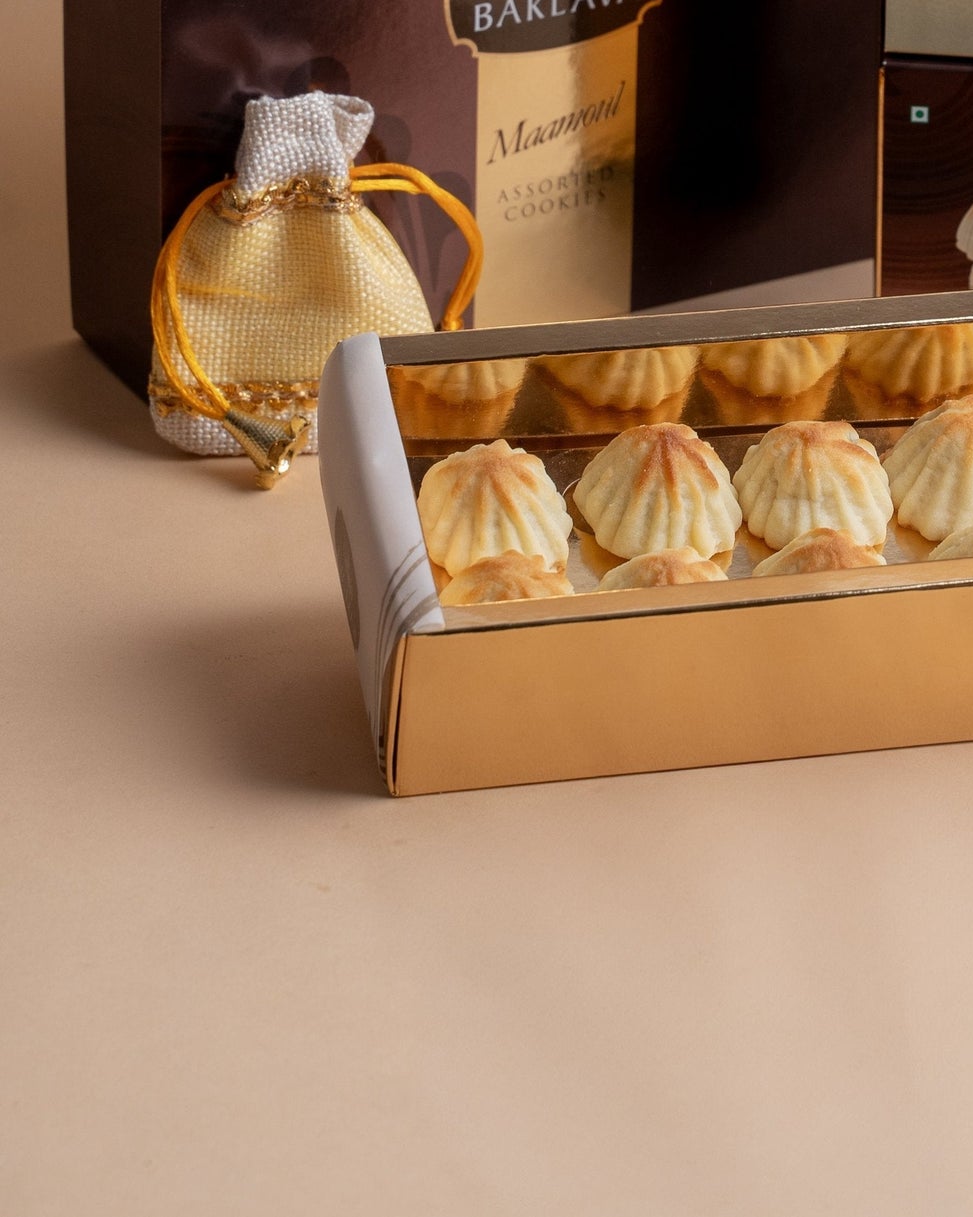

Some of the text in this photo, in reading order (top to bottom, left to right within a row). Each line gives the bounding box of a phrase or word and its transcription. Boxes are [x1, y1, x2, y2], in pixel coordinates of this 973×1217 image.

[487, 81, 626, 165] Maamoul
[497, 166, 614, 204] ASSORTED
[504, 190, 606, 222] COOKIES
